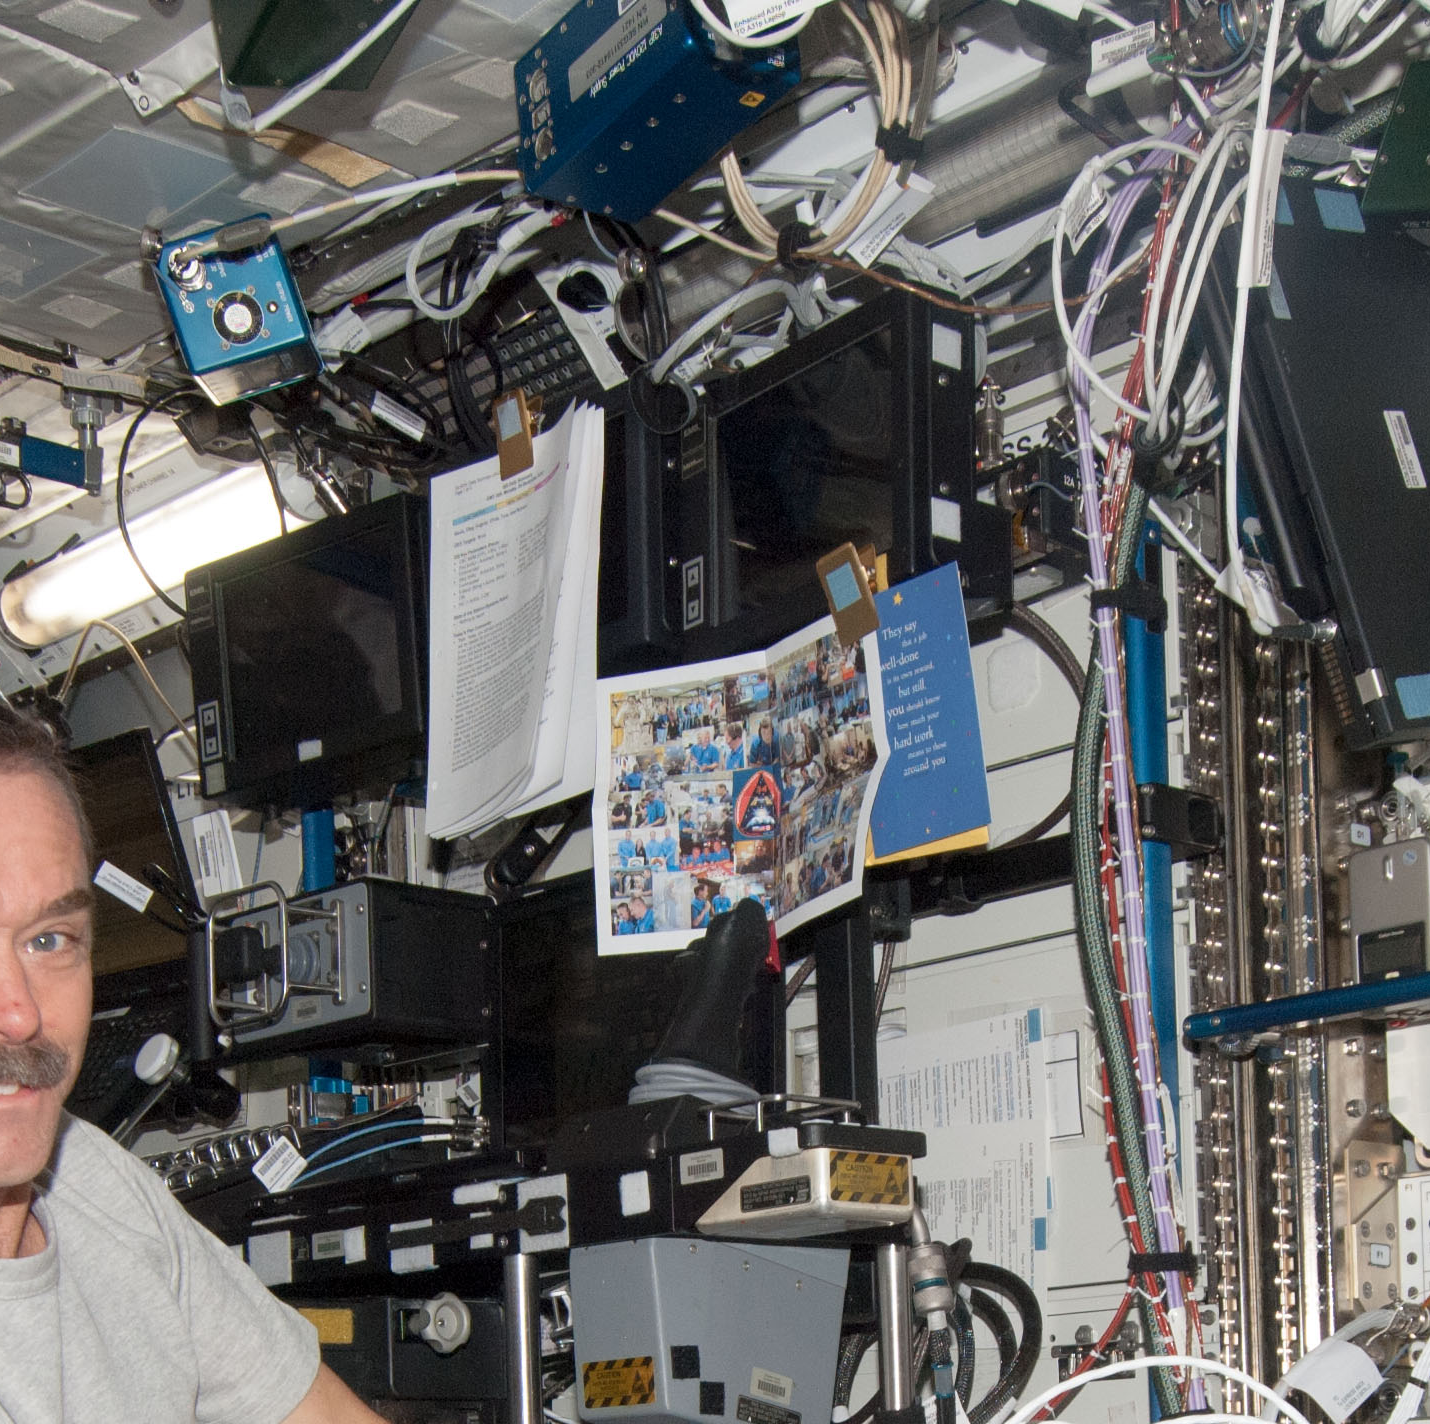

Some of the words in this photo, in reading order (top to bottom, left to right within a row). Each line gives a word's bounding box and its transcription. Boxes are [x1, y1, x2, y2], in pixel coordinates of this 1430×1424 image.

[734, 10, 765, 28] Enhanced
[764, 12, 786, 27] Laptop
[882, 626, 902, 640] They
[904, 620, 917, 633] say
[898, 685, 911, 698] but
[887, 705, 905, 722] you
[894, 731, 912, 750] hard
[914, 725, 933, 743] work
[903, 757, 930, 776] around
[932, 756, 946, 769] you
